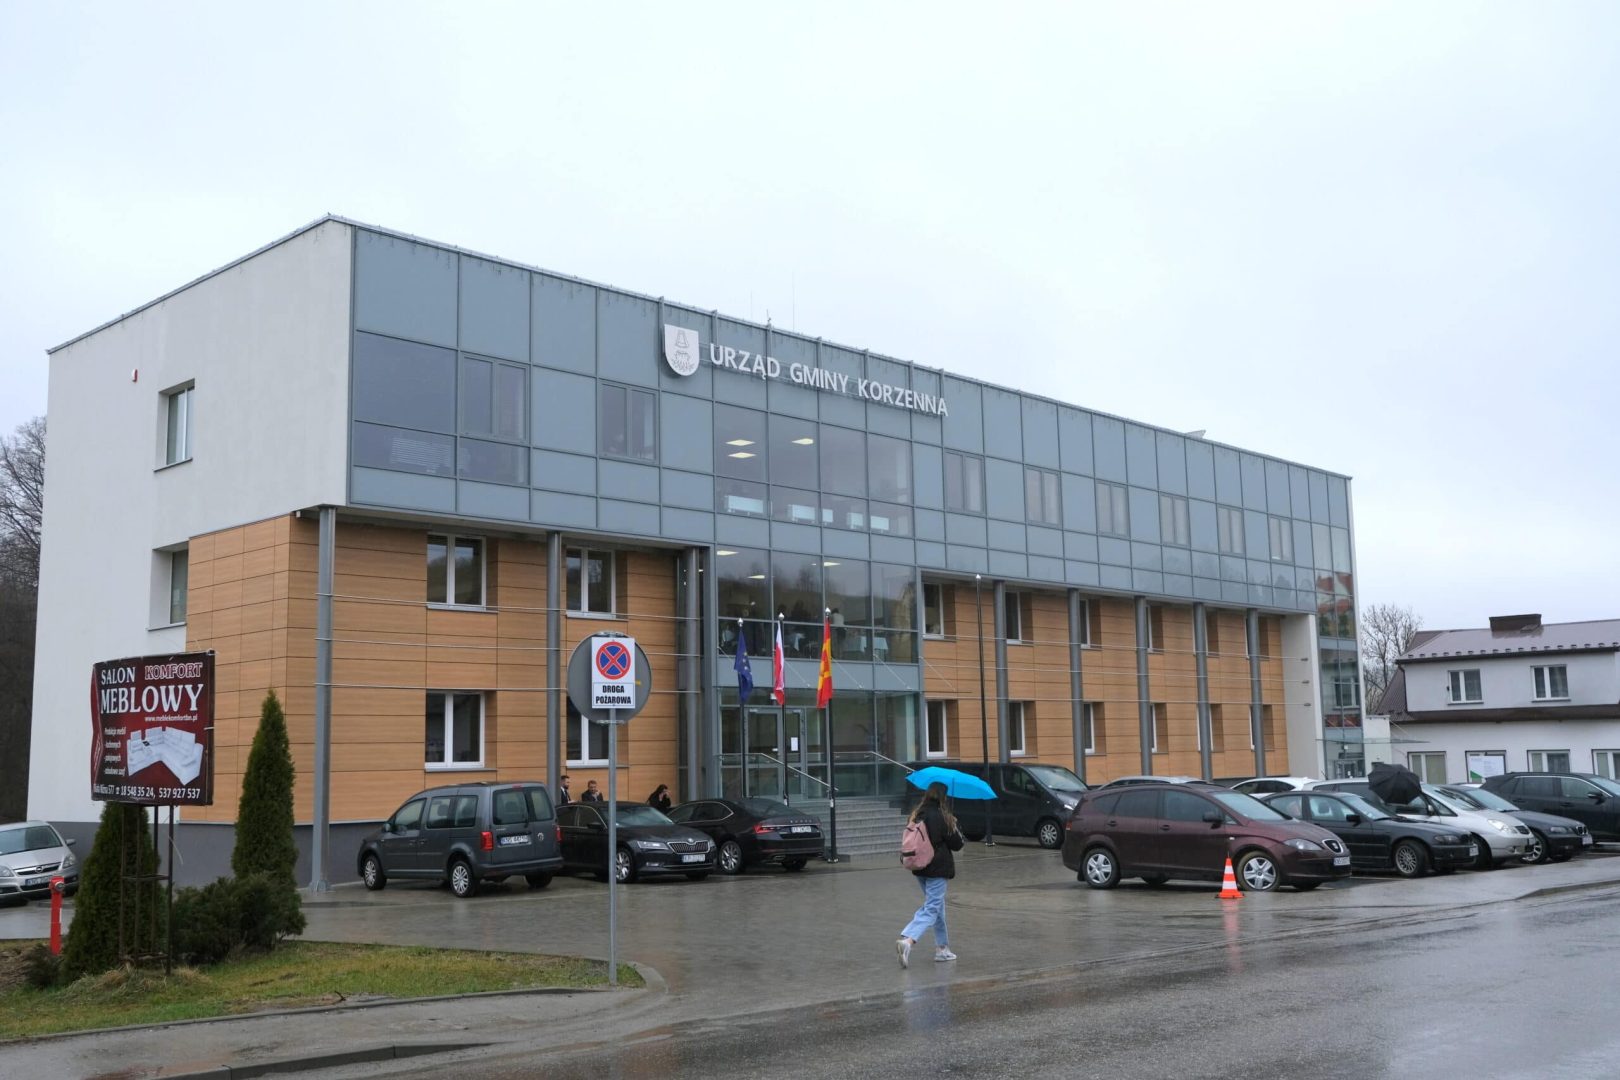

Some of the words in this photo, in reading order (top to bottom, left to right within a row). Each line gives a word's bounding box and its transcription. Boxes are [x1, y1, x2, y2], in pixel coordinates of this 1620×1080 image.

[709, 343, 780, 380] URZĄD
[790, 362, 849, 393] GMINY
[858, 379, 949, 416] KORZENNA
[101, 666, 136, 685] SALON
[144, 662, 203, 680] KOMFORT
[602, 685, 625, 693] DROGA
[100, 683, 204, 715] MEBLOWY
[595, 695, 632, 704] POŻAROWA
[137, 786, 145, 797] 35
[158, 787, 172, 798] 537
[172, 787, 186, 799] 927
[186, 787, 201, 799] 537
